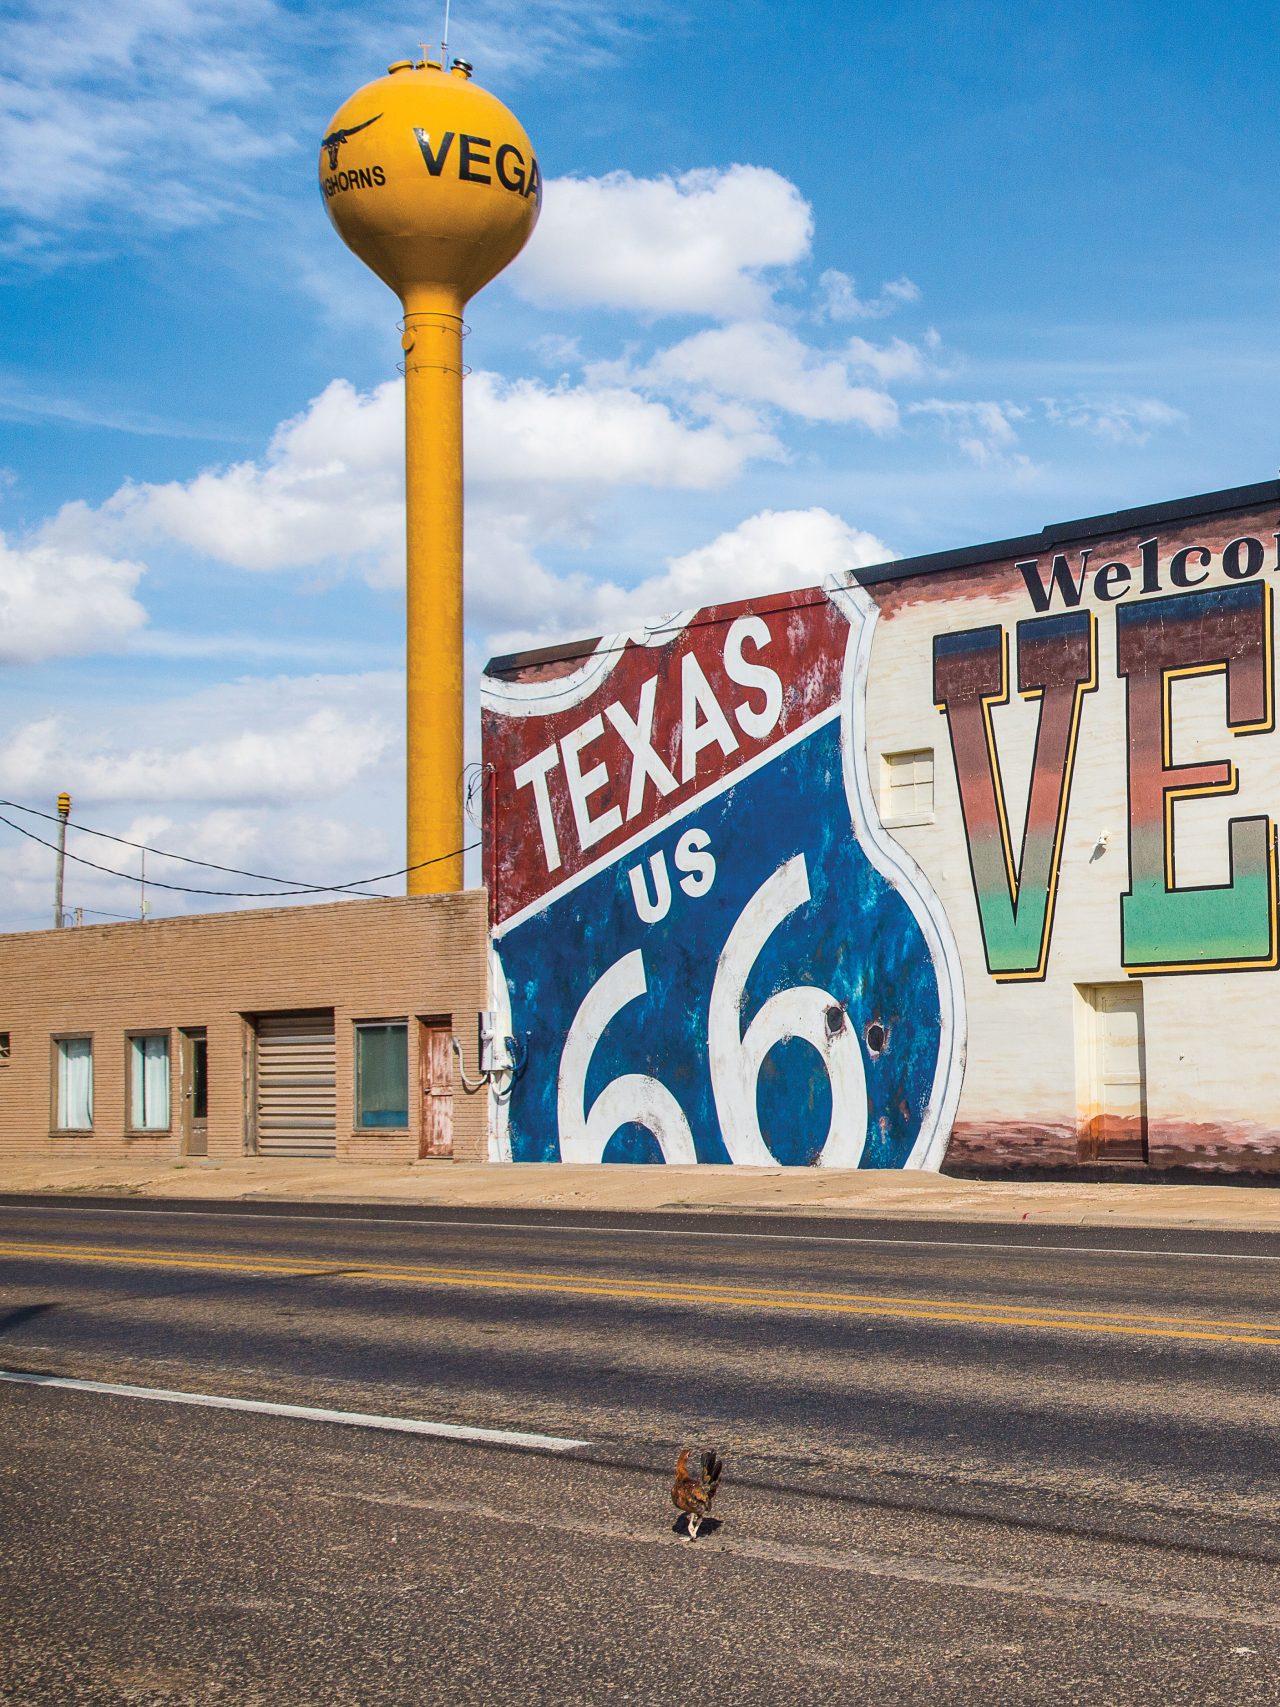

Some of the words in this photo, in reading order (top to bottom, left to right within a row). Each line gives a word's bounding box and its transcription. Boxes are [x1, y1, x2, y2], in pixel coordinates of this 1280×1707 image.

[413, 127, 540, 204] VEGA
[514, 615, 782, 873] TEXAS
[629, 828, 716, 923] US
[557, 853, 868, 1169] 66
